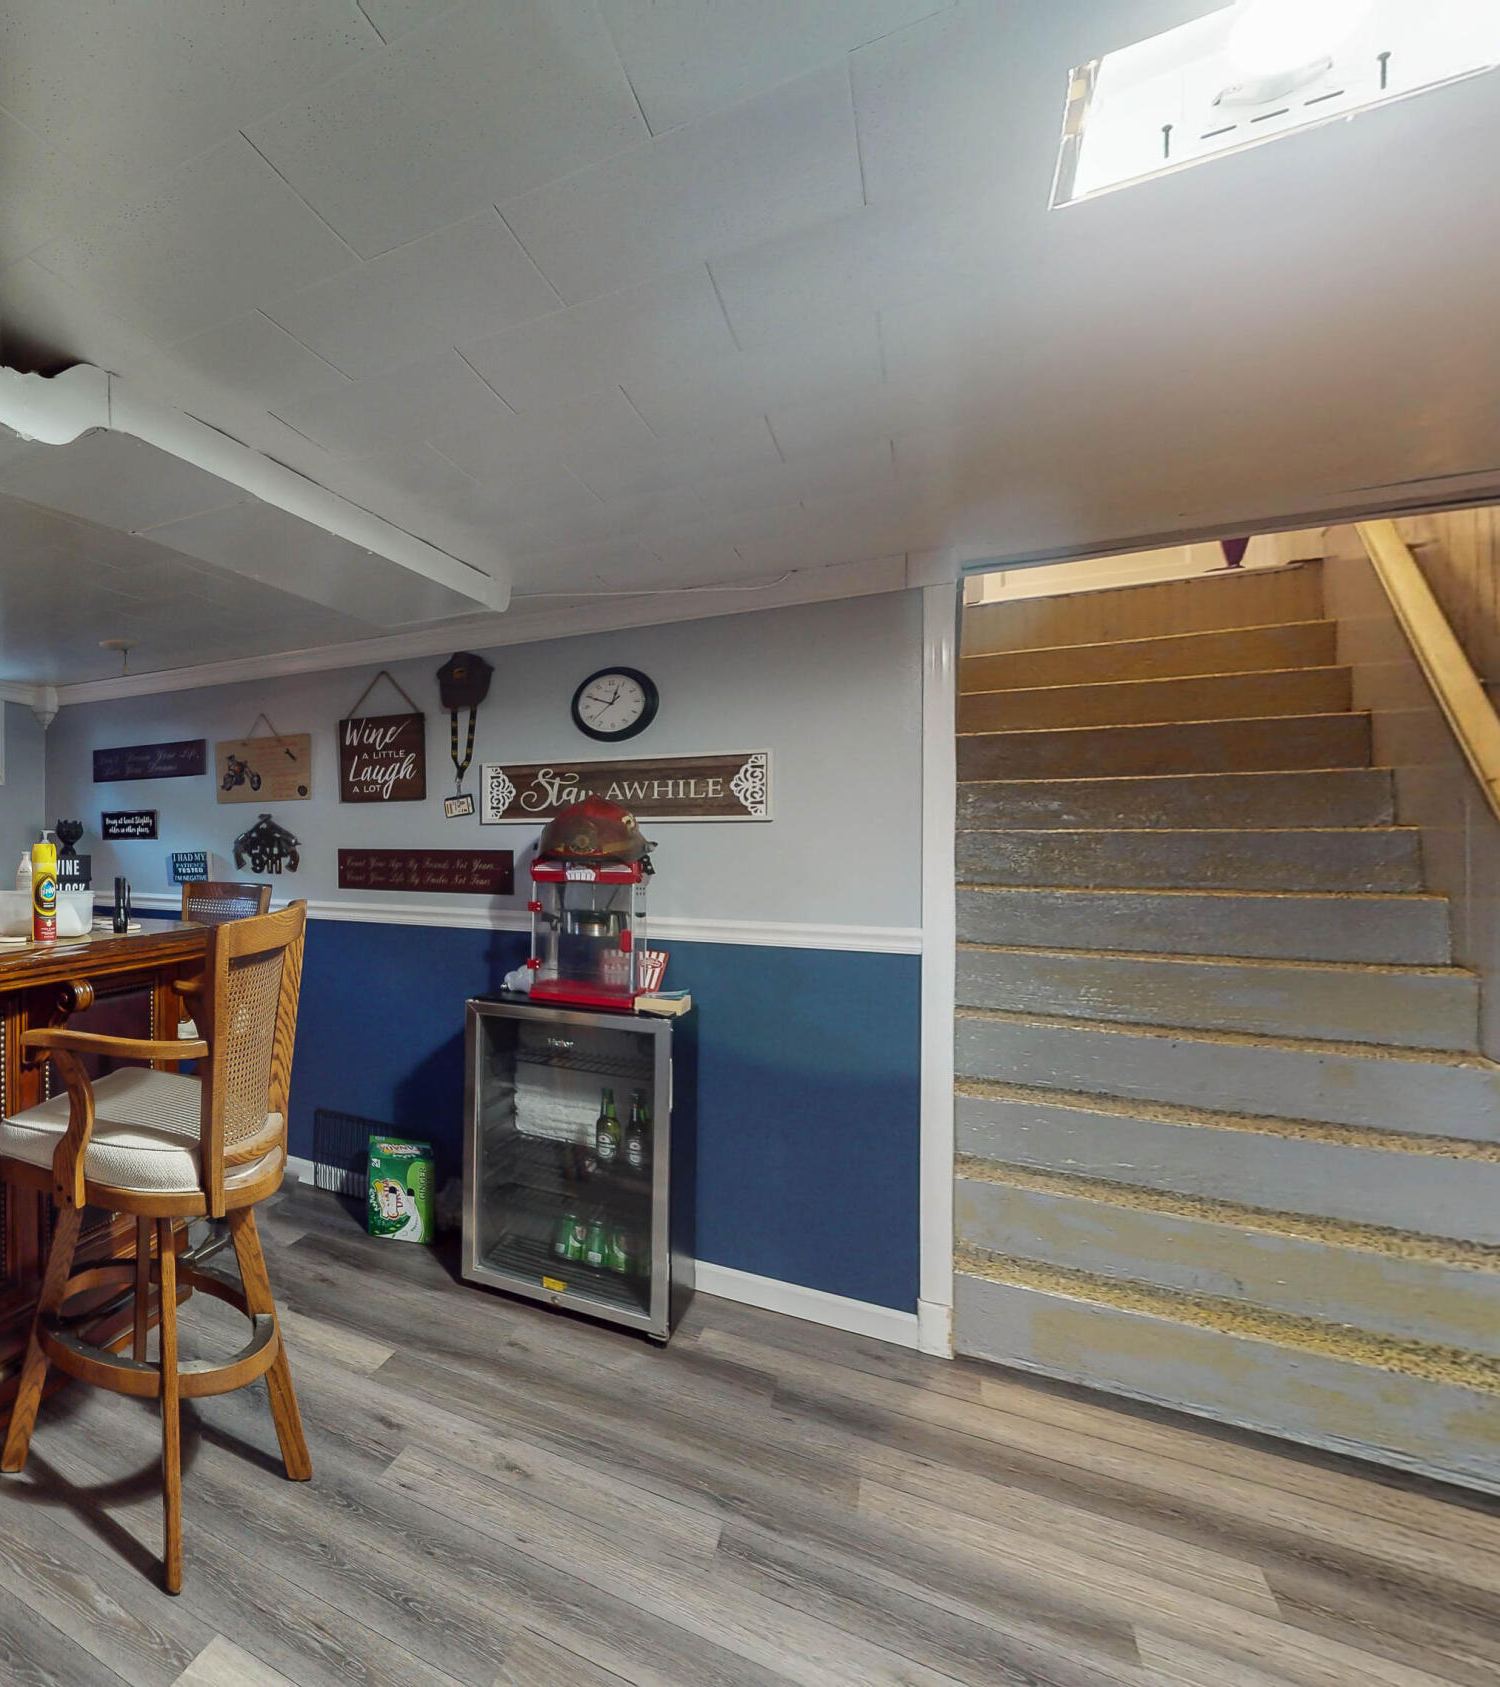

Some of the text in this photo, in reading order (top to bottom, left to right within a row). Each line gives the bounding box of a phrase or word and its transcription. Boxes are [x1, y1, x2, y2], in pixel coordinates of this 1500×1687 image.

[345, 718, 412, 750] Wine
[373, 750, 406, 760] LITTLE
[349, 753, 417, 800] Laugh
[352, 784, 382, 793] A LOT
[605, 778, 724, 800] AWHILE
[177, 853, 194, 862] HAD
[194, 853, 205, 861] MY
